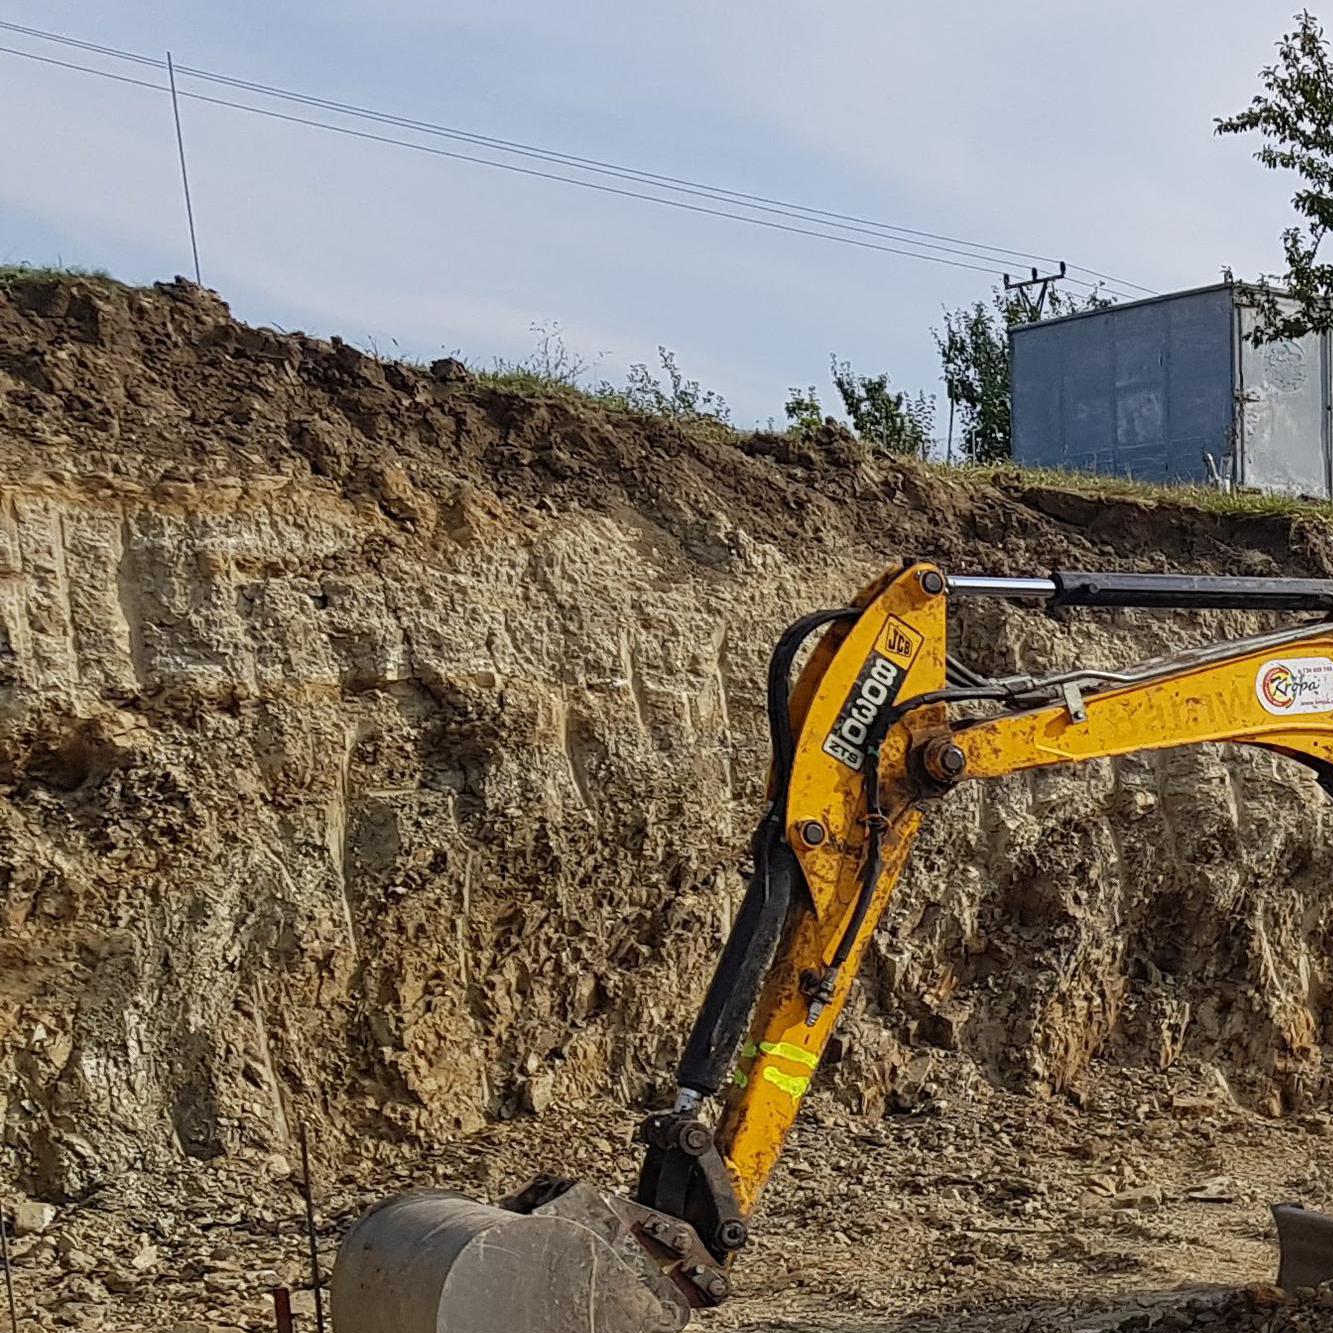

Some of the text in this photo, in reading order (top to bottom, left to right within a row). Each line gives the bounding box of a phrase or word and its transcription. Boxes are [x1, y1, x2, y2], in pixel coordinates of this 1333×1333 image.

[888, 628, 912, 655] JCB
[841, 658, 898, 745] 8030
[828, 740, 858, 764] ZTS
